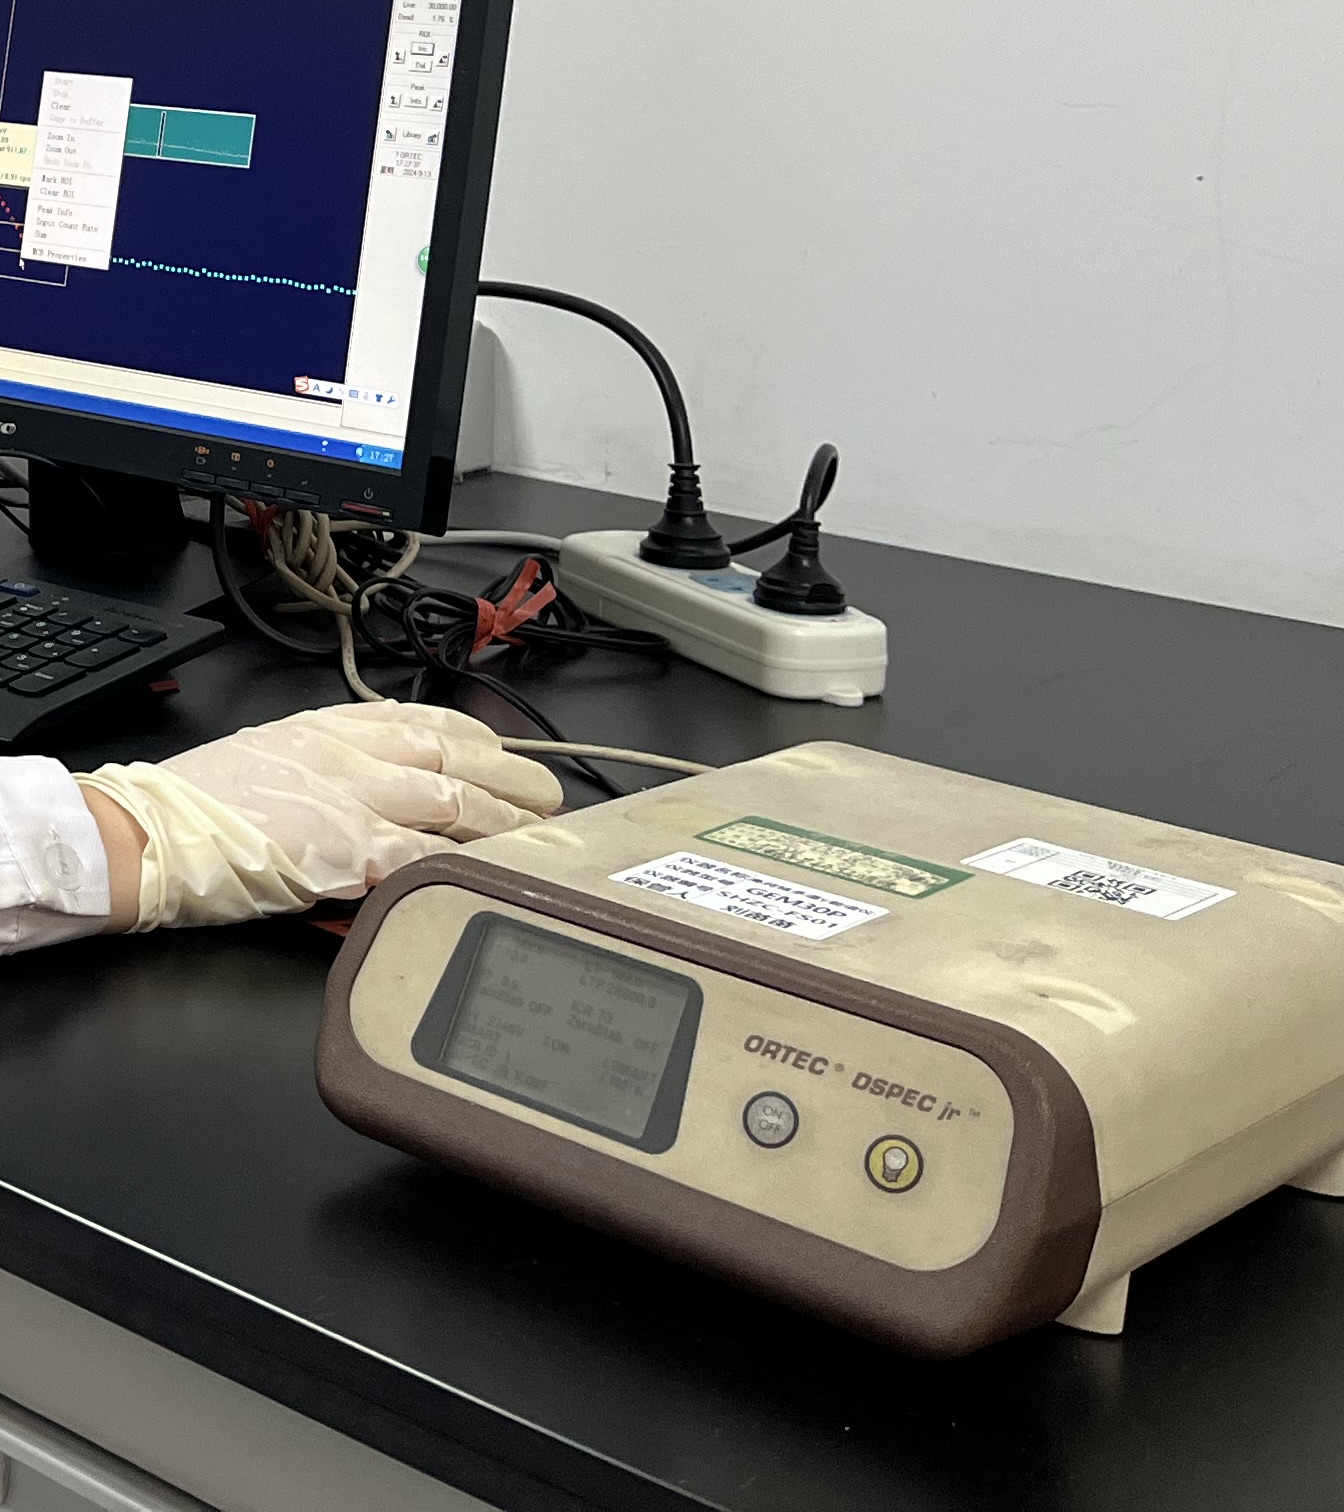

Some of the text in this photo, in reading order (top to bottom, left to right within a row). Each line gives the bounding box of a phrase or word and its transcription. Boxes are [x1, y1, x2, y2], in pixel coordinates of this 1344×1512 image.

[51, 102, 71, 110] Clear
[47, 132, 63, 141] Zoom
[46, 144, 62, 153] Zoom
[40, 188, 60, 196] Clear
[37, 205, 53, 214] Peak
[58, 221, 78, 230] Count
[82, 224, 99, 232] Rate
[369, 451, 394, 463] 17:27
[745, 888, 847, 918] GEM30P
[716, 890, 839, 928] SHZC-FS01
[743, 1035, 829, 1075] ORTEC
[851, 1071, 938, 1112] DSPEC
[937, 1102, 961, 1120] jr
[762, 1105, 783, 1120] ON
[759, 1120, 781, 1133] OFF
